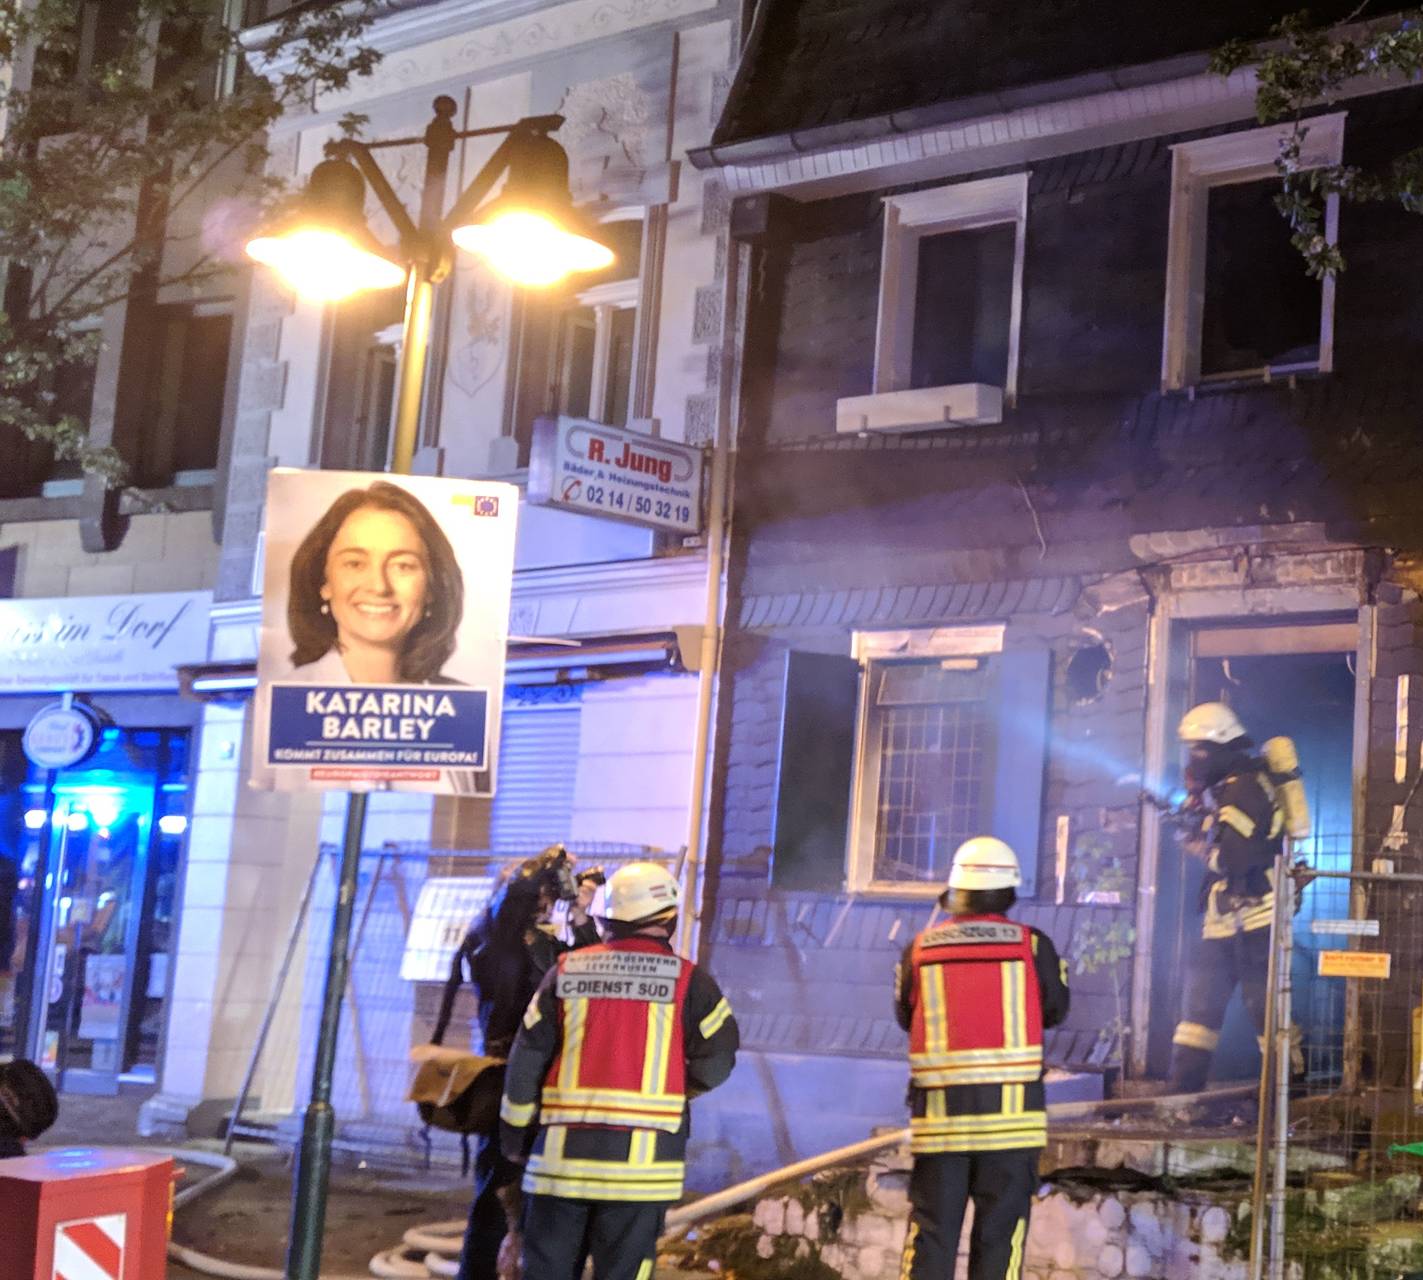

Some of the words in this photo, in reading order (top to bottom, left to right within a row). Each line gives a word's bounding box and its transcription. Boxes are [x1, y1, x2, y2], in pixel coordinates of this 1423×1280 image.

[588, 438, 611, 464] R.
[615, 443, 672, 483] Jung
[609, 472, 691, 498] Heizungstechnik
[587, 485, 604, 504] 02
[609, 491, 624, 508] 14
[635, 497, 651, 514] 50
[655, 501, 671, 519] 32
[676, 506, 690, 523] 19
[100, 599, 193, 650] Dorf
[306, 691, 457, 717] KATARINA
[322, 716, 436, 740] BARLEY
[274, 748, 321, 761] KOMMT
[323, 748, 394, 763] ZUSAMMEN
[396, 749, 420, 763] FÜR
[424, 751, 478, 764] EUROPA!
[562, 980, 634, 995] C-DIENST
[638, 983, 669, 997] SÜD
